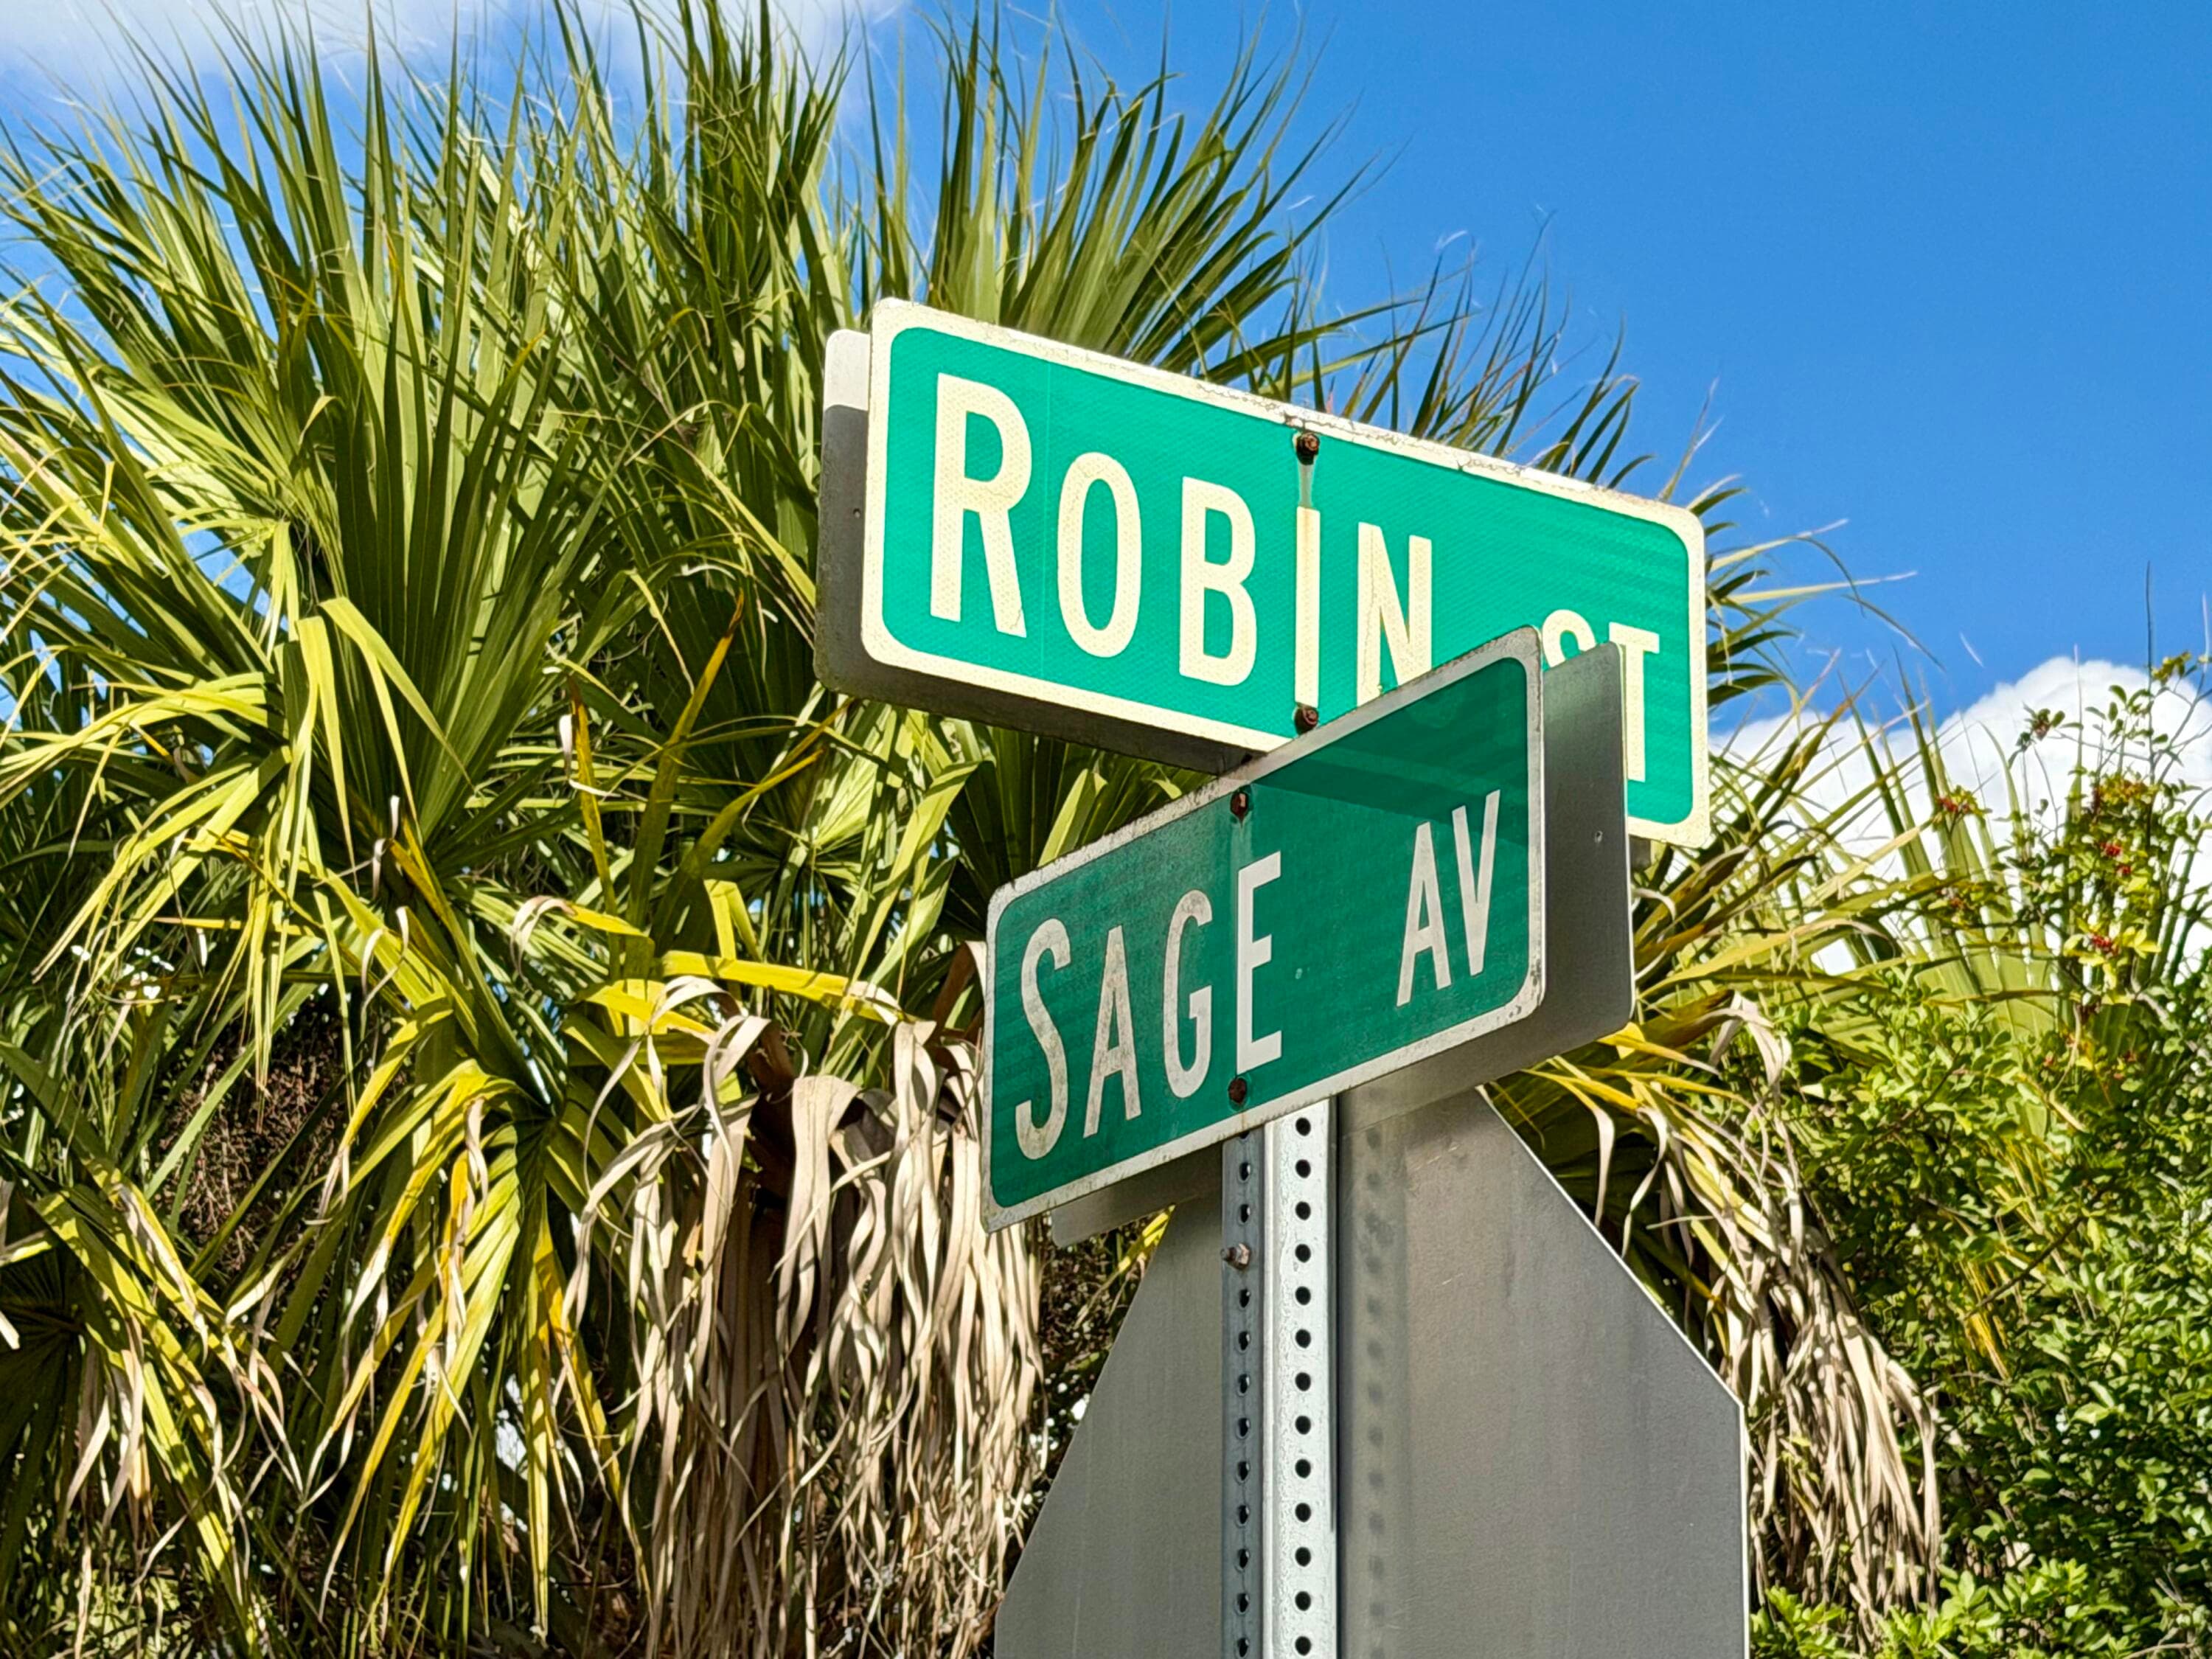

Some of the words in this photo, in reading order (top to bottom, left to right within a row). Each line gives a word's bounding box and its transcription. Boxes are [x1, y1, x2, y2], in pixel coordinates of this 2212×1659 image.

[930, 372, 1433, 709] ROBIN
[1015, 850, 1281, 1160] SAGE
[1397, 790, 1500, 1008] AV
